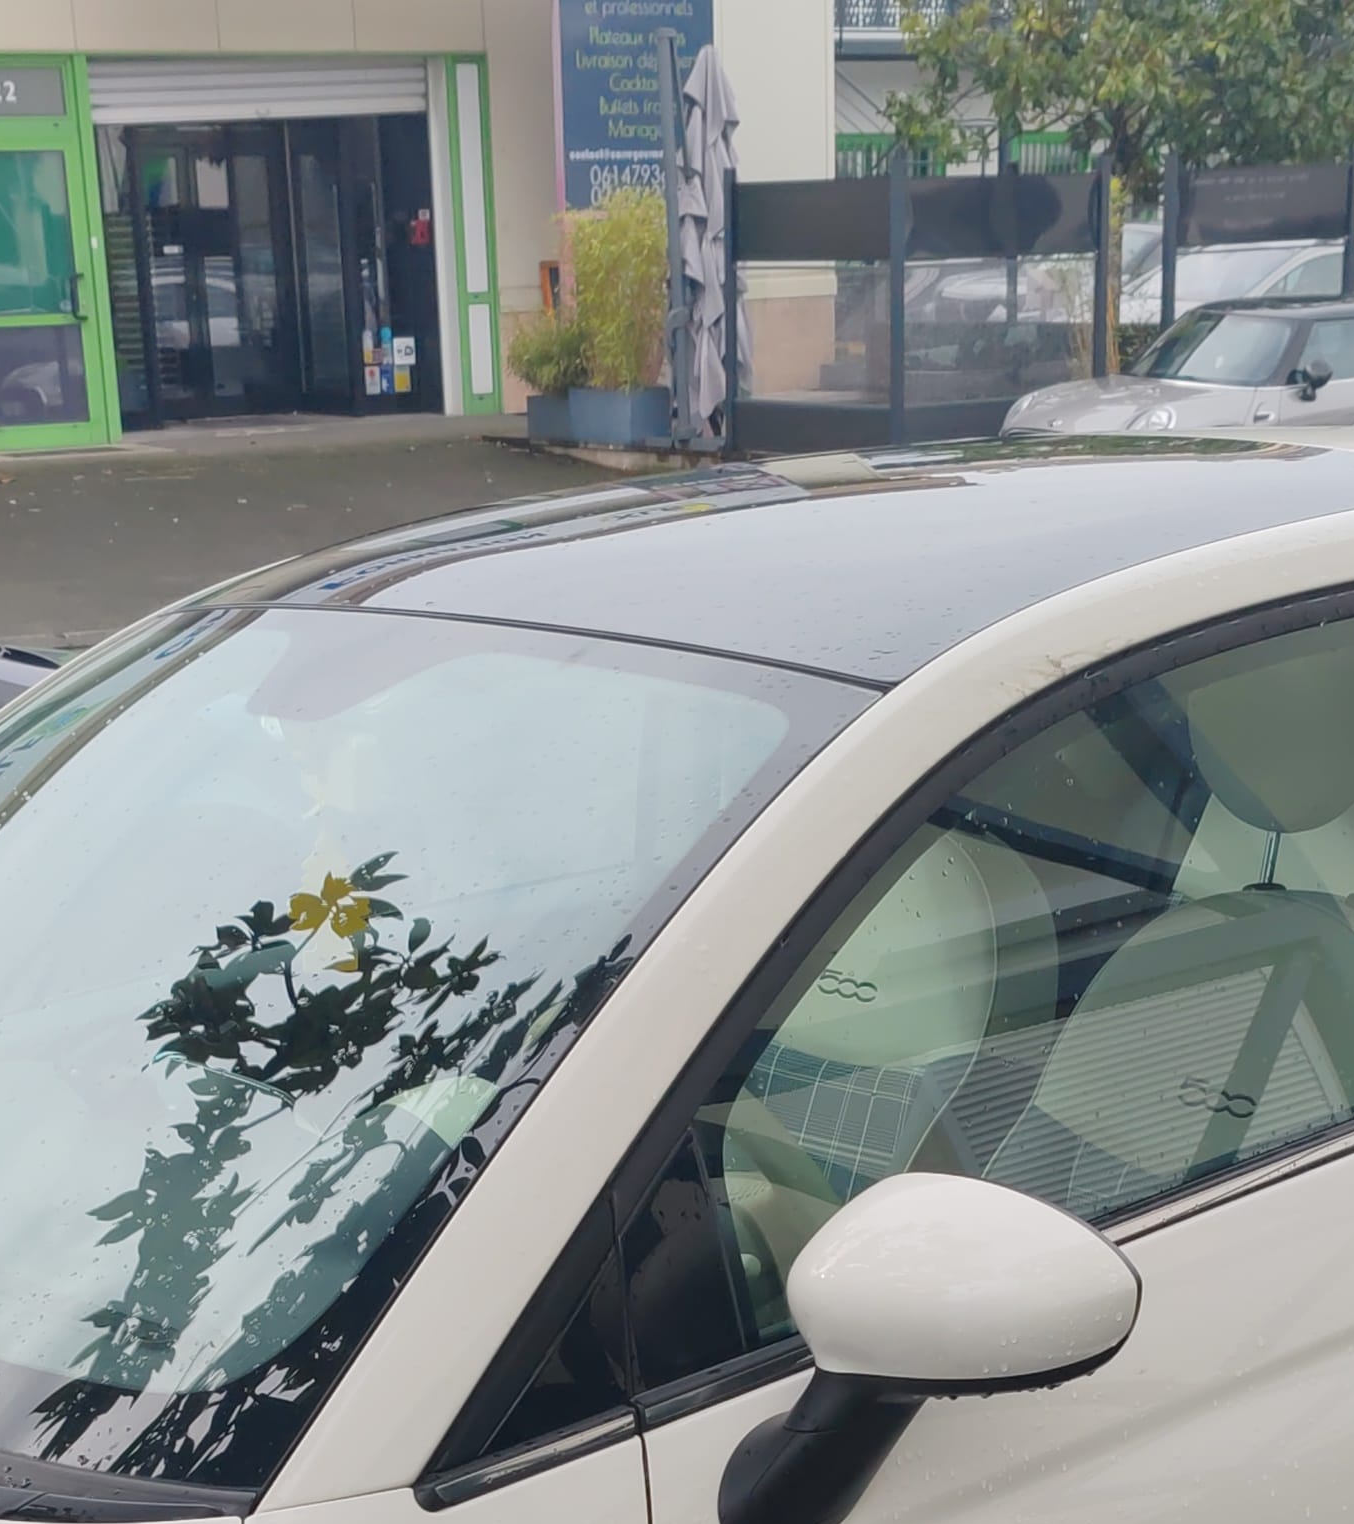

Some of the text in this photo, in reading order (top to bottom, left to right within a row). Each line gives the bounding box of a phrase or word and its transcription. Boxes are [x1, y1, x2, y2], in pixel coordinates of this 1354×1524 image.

[588, 25, 644, 45] Plateaux
[575, 49, 633, 70] Livraison
[609, 72, 659, 92] Cockta
[607, 119, 660, 141] Mariag
[817, 969, 878, 1003] 500
[1177, 1078, 1258, 1119] 500
